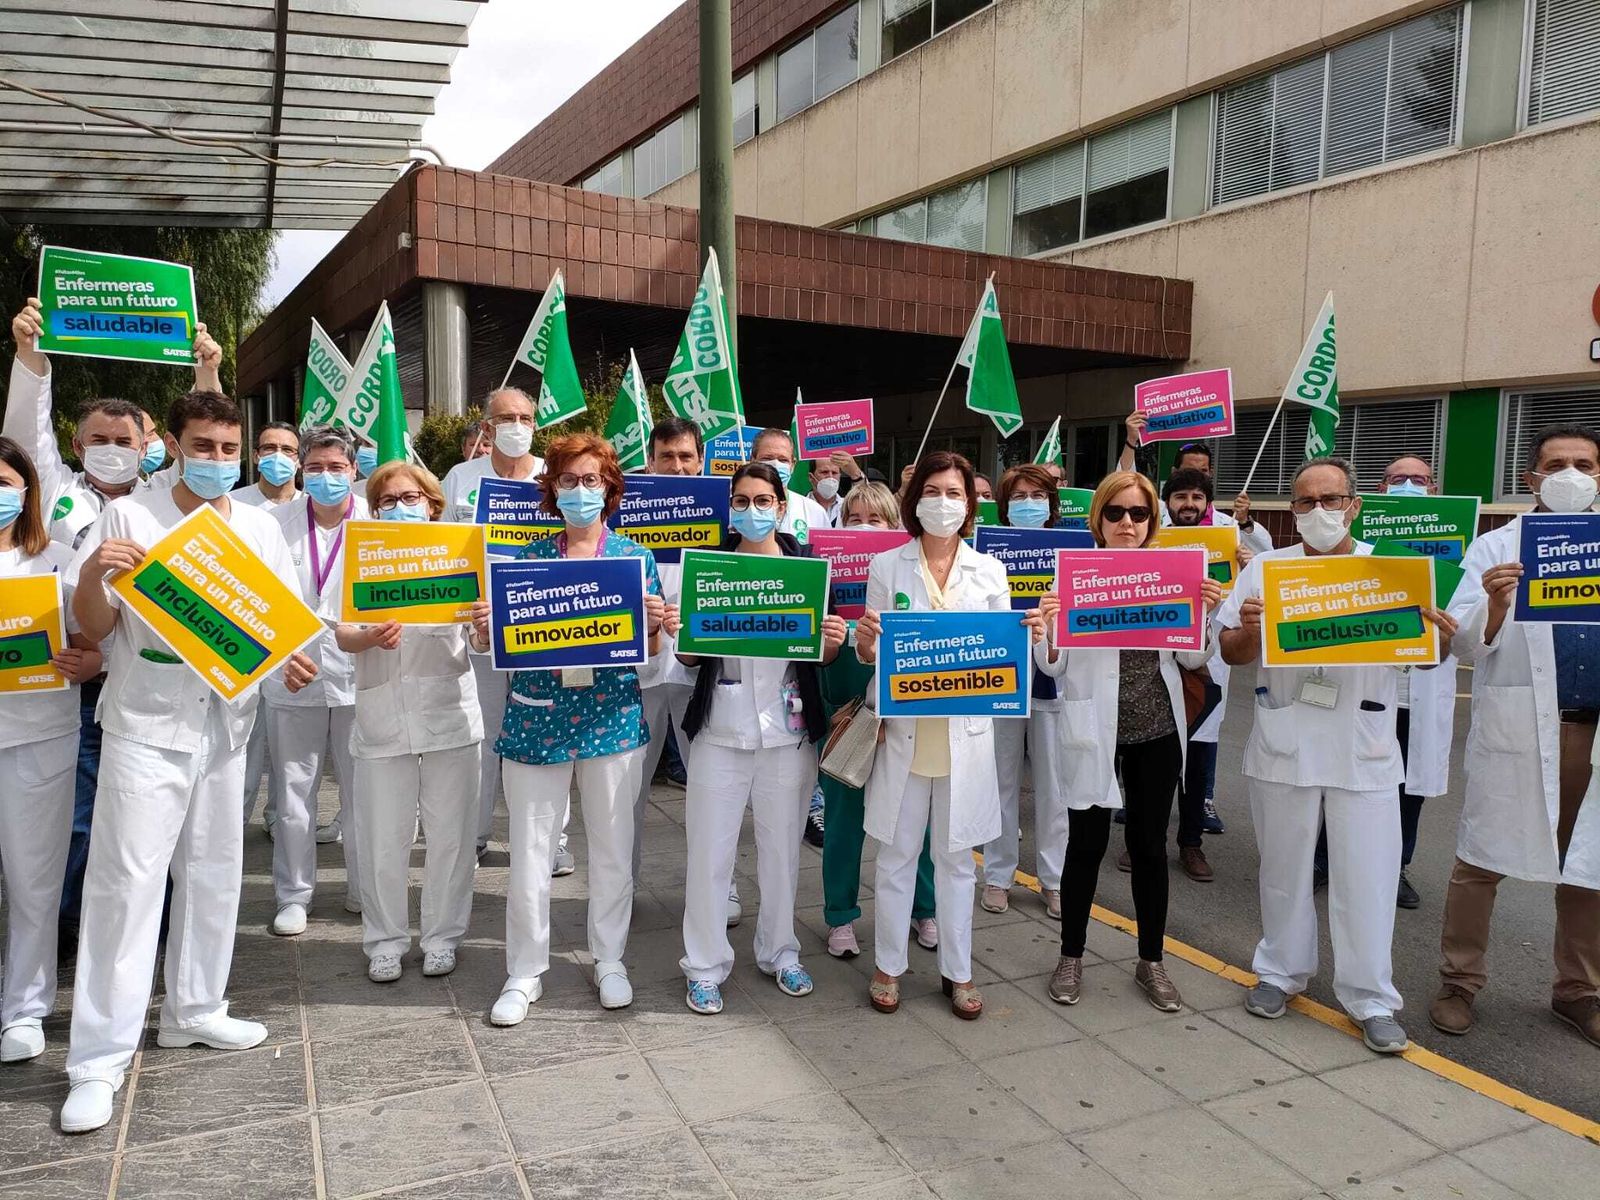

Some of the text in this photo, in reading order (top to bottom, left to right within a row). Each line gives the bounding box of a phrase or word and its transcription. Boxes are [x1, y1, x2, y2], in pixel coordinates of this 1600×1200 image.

[54, 276, 155, 292] Enfermeras
[56, 293, 178, 308] para un futuro
[64, 315, 174, 334] saludable
[1296, 314, 1337, 400] CORDO
[1143, 386, 1202, 407] Enfermeras
[1145, 393, 1217, 418] para un futuro
[804, 413, 851, 427] Enfermeras
[806, 426, 825, 436] para
[836, 419, 862, 429] futuro
[1149, 410, 1216, 430] equitativo
[808, 433, 861, 448] equitativo
[714, 449, 735, 458] para
[619, 495, 695, 510] Enfermeras
[489, 512, 516, 522] para
[517, 512, 533, 520] un
[620, 506, 713, 526] para un futuro
[1362, 513, 1439, 526] Enfermeras
[1362, 523, 1457, 539] para un futuro
[357, 544, 449, 562] Enfermeras
[183, 537, 271, 614] Enfermeras
[359, 557, 469, 579] para un futuro
[830, 567, 852, 578] ara
[1018, 561, 1035, 571] un
[1538, 560, 1581, 578] para
[696, 578, 784, 592] Enfermeras
[1072, 571, 1161, 590] Enfermeras
[1279, 578, 1381, 601] Enfermeras
[166, 553, 276, 641] para un futuro
[370, 583, 461, 602] inclusivo
[506, 581, 599, 604] Enfermeras
[697, 592, 805, 611] para un futuro
[1073, 583, 1183, 607] para un futuro
[509, 594, 622, 623] para un futuro
[1282, 590, 1408, 619] para un futuro
[154, 577, 240, 656] inclusivo
[701, 615, 799, 632] saludable
[1076, 607, 1179, 630] equitativo
[515, 620, 621, 645] innovador
[1296, 619, 1399, 643] inclusivo
[894, 633, 985, 654] Enfermeras
[610, 649, 638, 658] SATSE
[896, 646, 1008, 672] para un futuro
[898, 671, 1004, 694] sostenible
[992, 702, 1021, 710] SATSE
